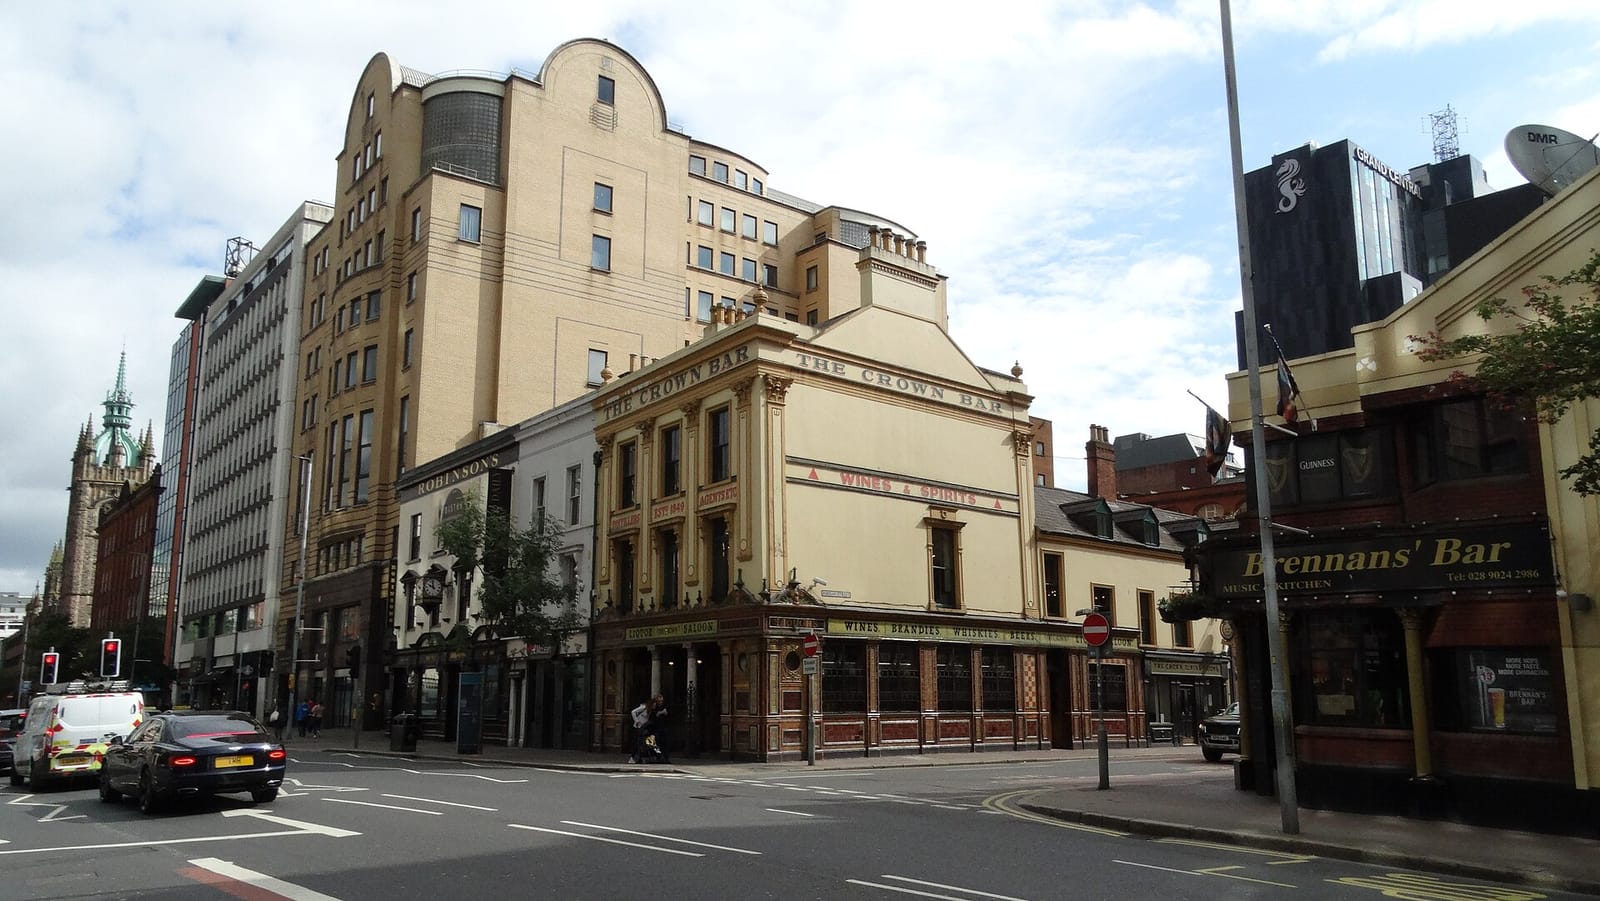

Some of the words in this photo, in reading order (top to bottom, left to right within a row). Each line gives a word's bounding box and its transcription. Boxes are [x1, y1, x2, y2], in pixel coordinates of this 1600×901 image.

[1527, 131, 1558, 145] DMR
[1357, 147, 1387, 174] GRAND
[1389, 169, 1423, 200] CENTRAL
[603, 395, 633, 420] THE
[639, 365, 702, 404] CROWN
[709, 345, 749, 375] BAR
[797, 353, 846, 376] THE
[862, 369, 945, 400] CROWN
[960, 393, 1003, 414] BAR
[1300, 459, 1335, 471] GUINNESS
[840, 472, 892, 492] WINES
[902, 485, 911, 494] &
[921, 485, 977, 505] SPIRITS
[1242, 539, 1422, 577] Brennans'
[1429, 538, 1511, 567] Bar
[1223, 584, 1260, 593] MUSIC
[1277, 580, 1332, 591] KITCHEN
[1447, 572, 1466, 582] Tel:
[1468, 571, 1487, 582] 028
[1488, 570, 1512, 581] 9024
[1514, 569, 1540, 580] 2986
[683, 622, 713, 634] SALOON
